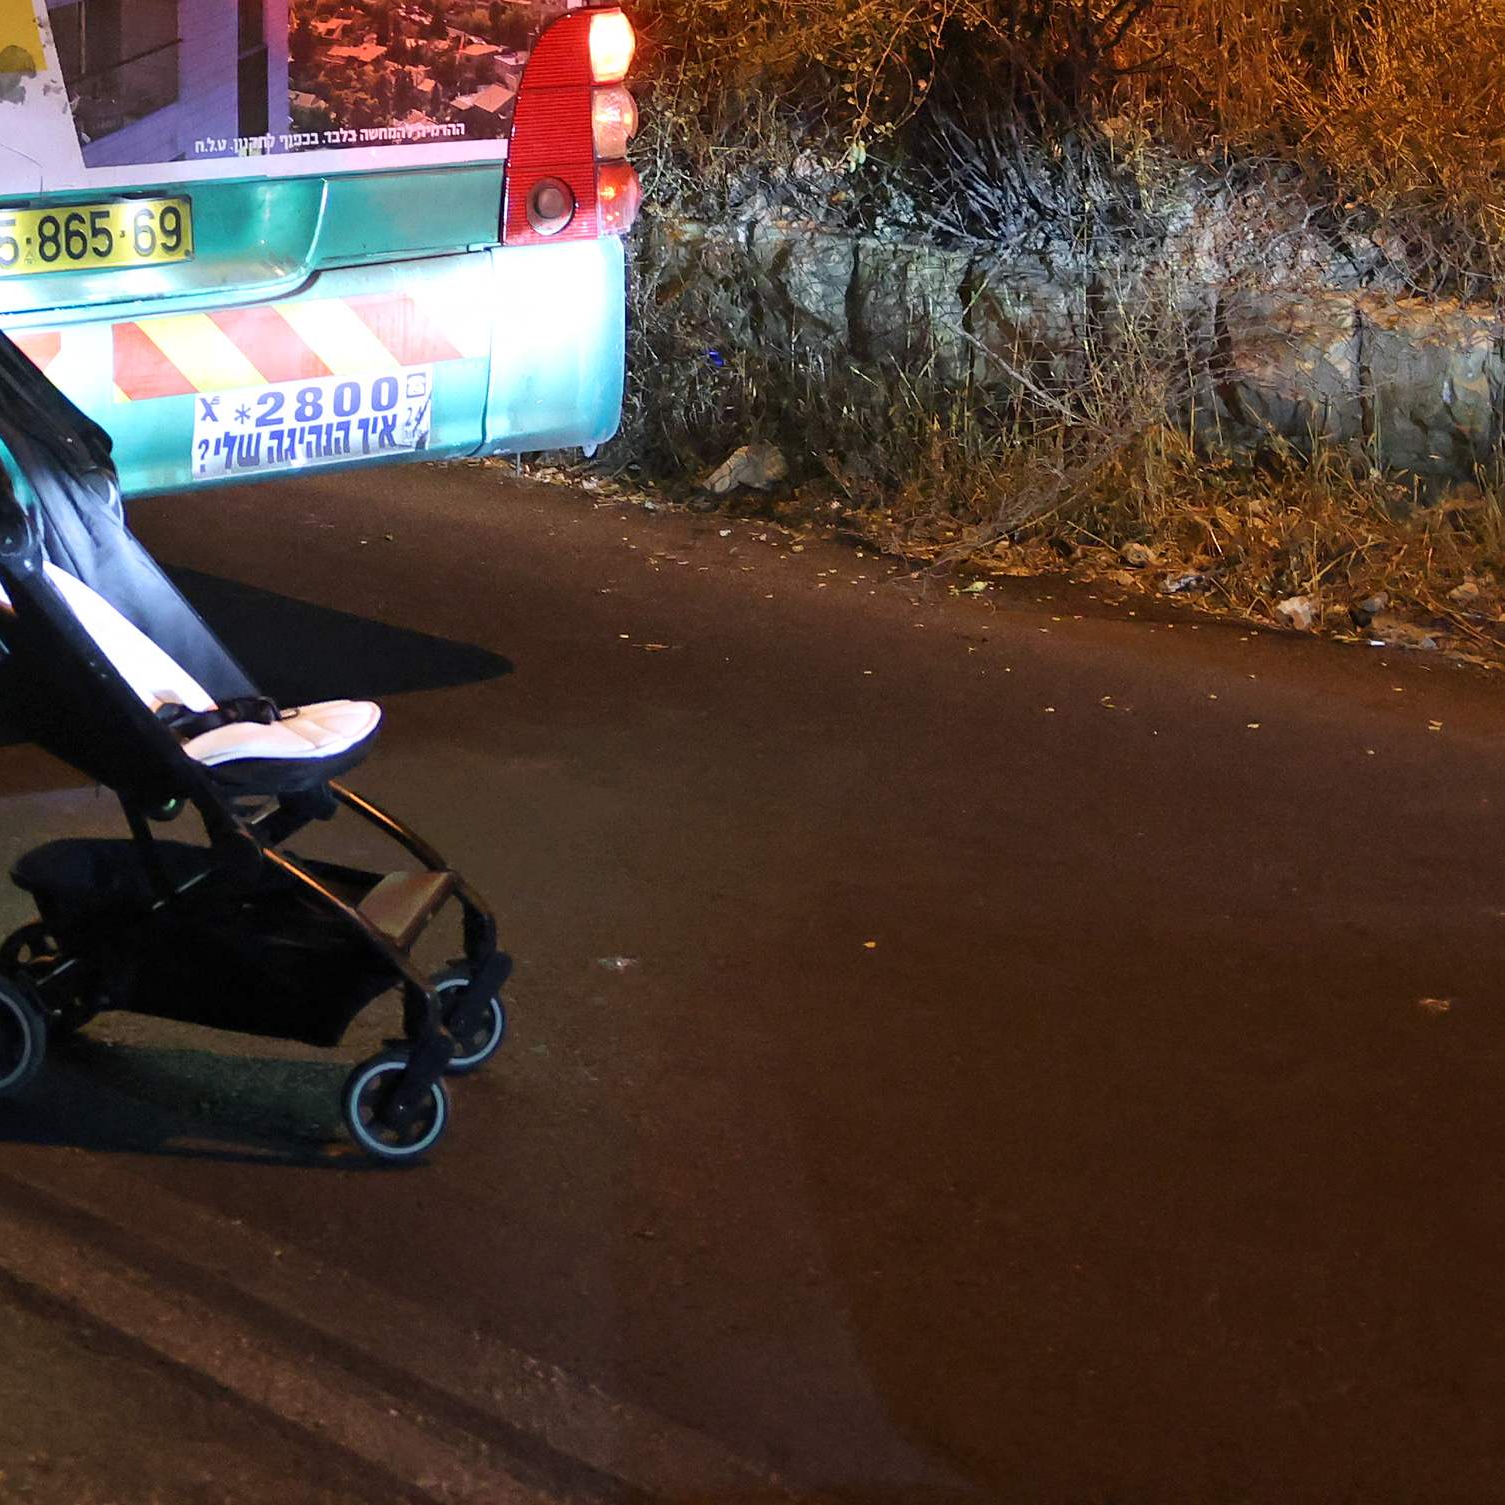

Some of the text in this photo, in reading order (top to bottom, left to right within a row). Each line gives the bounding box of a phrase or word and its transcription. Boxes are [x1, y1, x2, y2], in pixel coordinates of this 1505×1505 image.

[197, 413, 398, 473] איך הנהיגה שלי?
